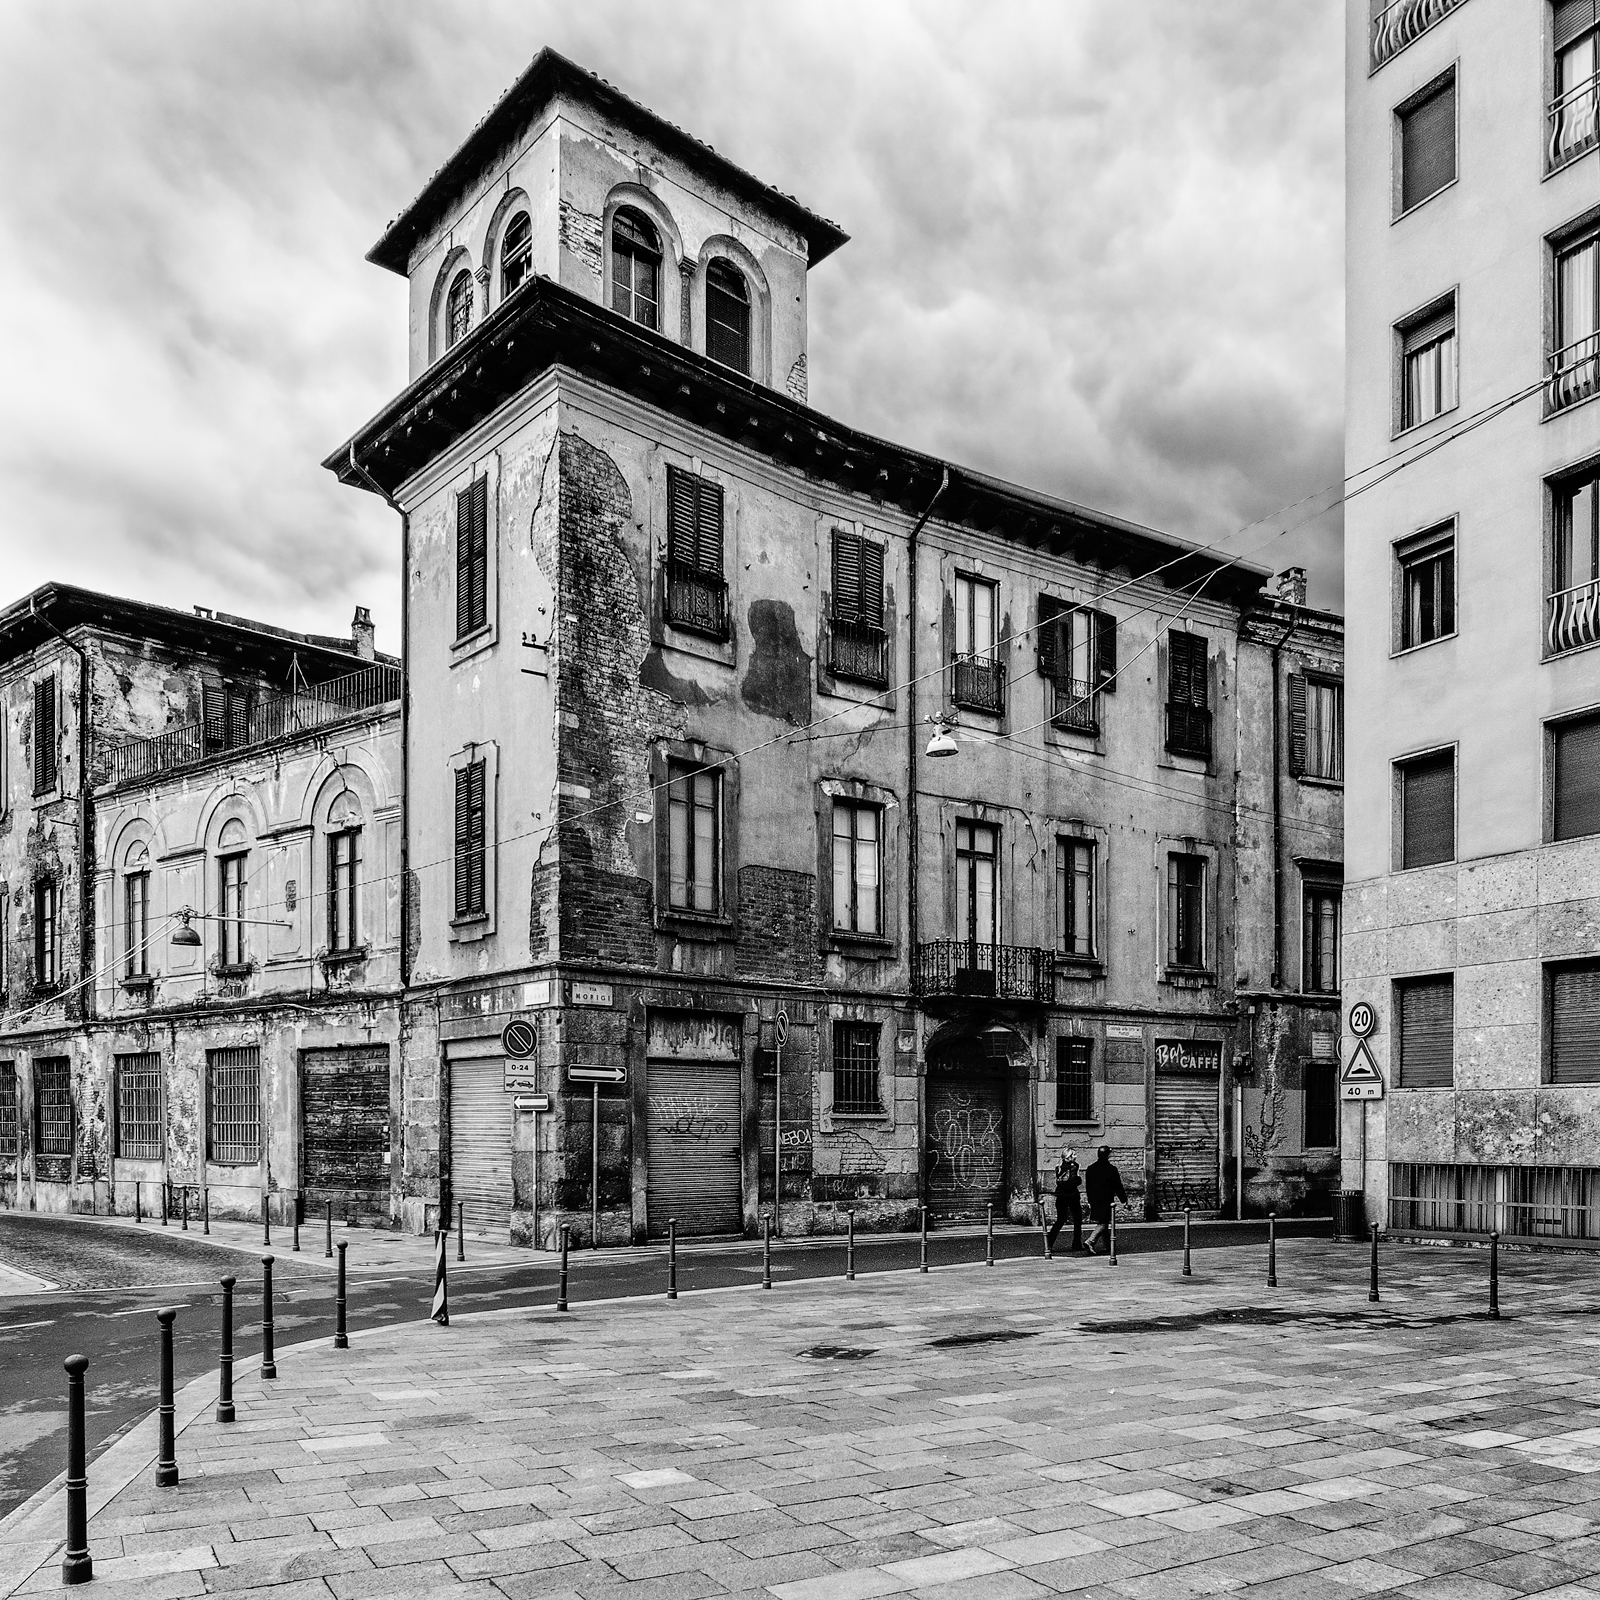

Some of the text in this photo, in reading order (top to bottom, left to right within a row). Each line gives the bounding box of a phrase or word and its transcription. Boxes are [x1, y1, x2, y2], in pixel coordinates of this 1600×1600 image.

[575, 993, 611, 1001] MORIGI
[1354, 1010, 1369, 1027] 20
[1155, 1043, 1185, 1067] Bar
[1347, 1087, 1361, 1096] 40
